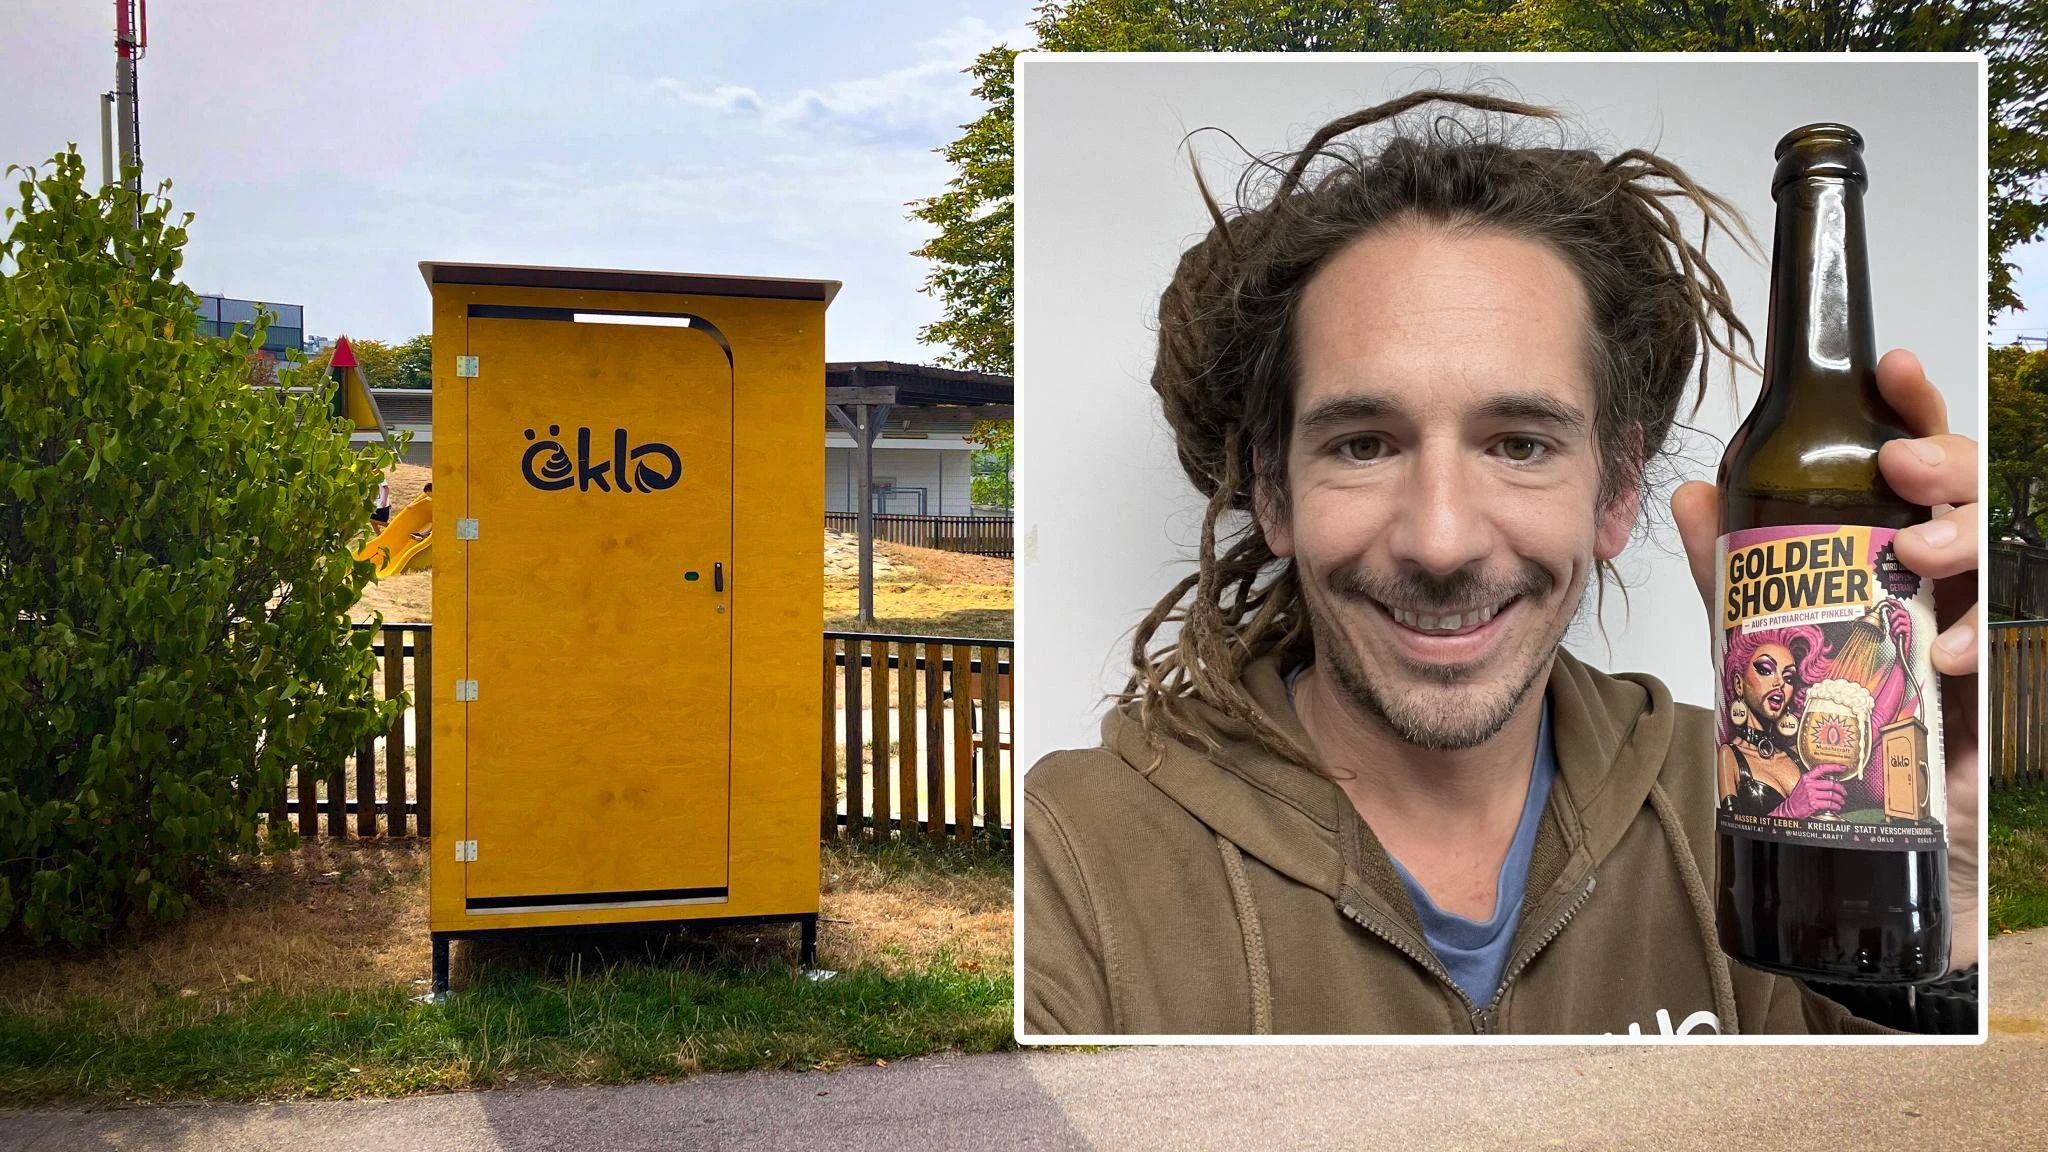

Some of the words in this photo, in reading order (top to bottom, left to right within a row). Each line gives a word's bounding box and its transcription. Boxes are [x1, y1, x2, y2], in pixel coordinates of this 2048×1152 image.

[1729, 536, 1854, 584] GOLDEN
[1727, 568, 1869, 621] SHOWER
[1751, 619, 1768, 629] AUFS
[1769, 612, 1819, 626] PATRIARCHAT
[1821, 608, 1854, 619] PINKELN
[1733, 814, 1757, 824] WASSER
[1760, 817, 1770, 826] IST
[1774, 819, 1802, 829] LEBEN.
[1807, 821, 1851, 833] KREISLAUF
[1854, 826, 1877, 834] STATT
